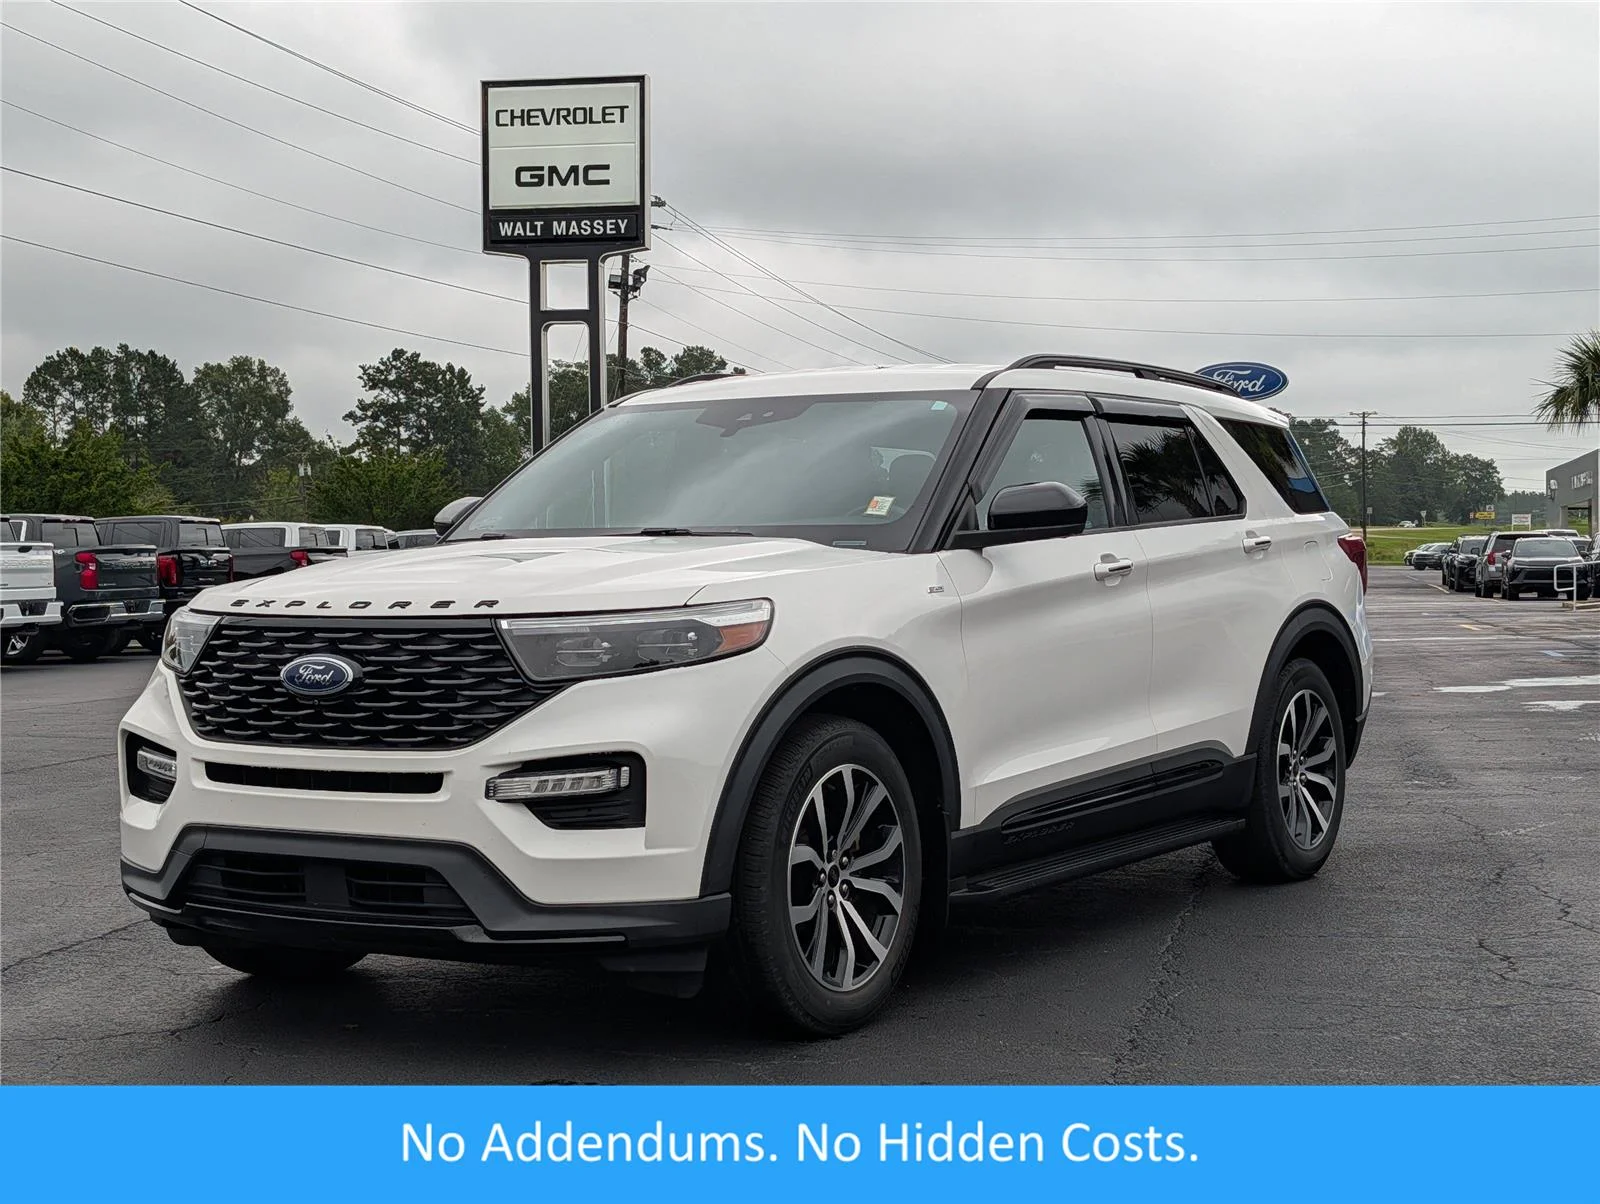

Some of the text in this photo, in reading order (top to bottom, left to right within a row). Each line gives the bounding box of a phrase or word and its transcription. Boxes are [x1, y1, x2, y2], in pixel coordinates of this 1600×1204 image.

[495, 105, 629, 126] CHEVROLET
[515, 164, 610, 187] GMC
[499, 219, 628, 236] WALT MASSEY
[229, 598, 500, 610] EXPLORER
[294, 663, 334, 686] Ford
